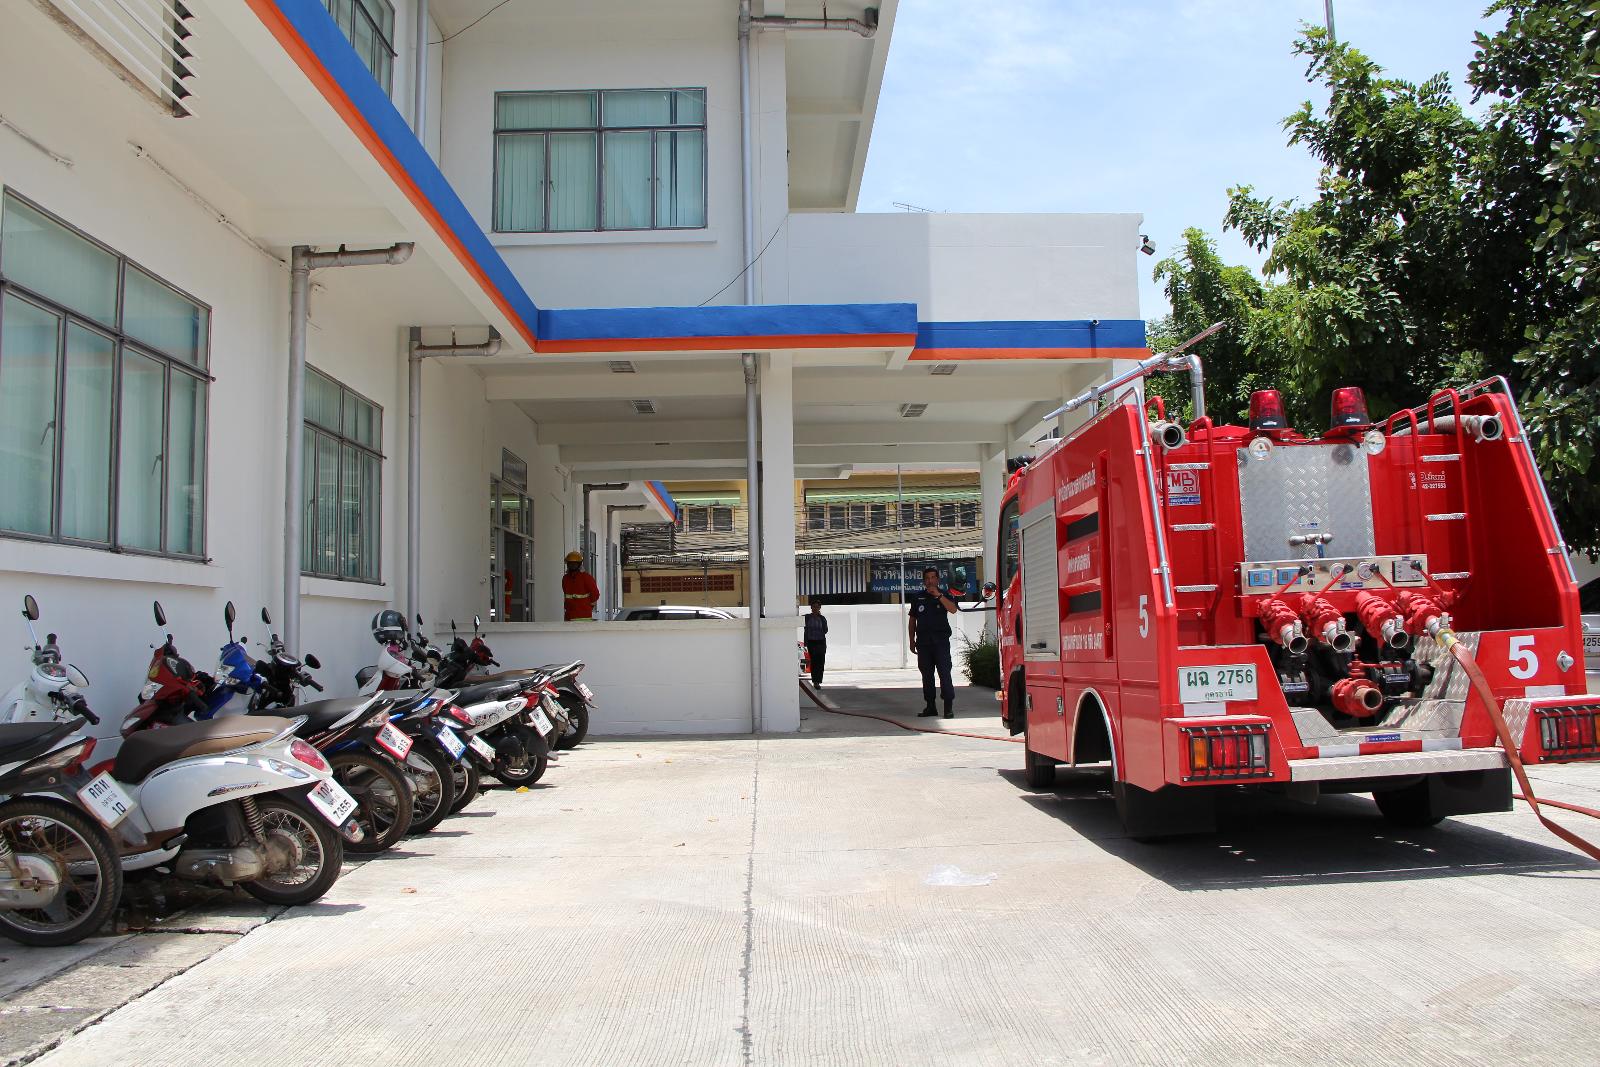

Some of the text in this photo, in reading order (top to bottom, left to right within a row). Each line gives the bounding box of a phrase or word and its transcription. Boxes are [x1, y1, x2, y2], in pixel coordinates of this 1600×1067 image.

[1138, 594, 1149, 638] 5
[1508, 634, 1539, 680] 5
[1217, 669, 1254, 685] 2756
[112, 801, 127, 816] 10
[332, 799, 352, 820] 7355
